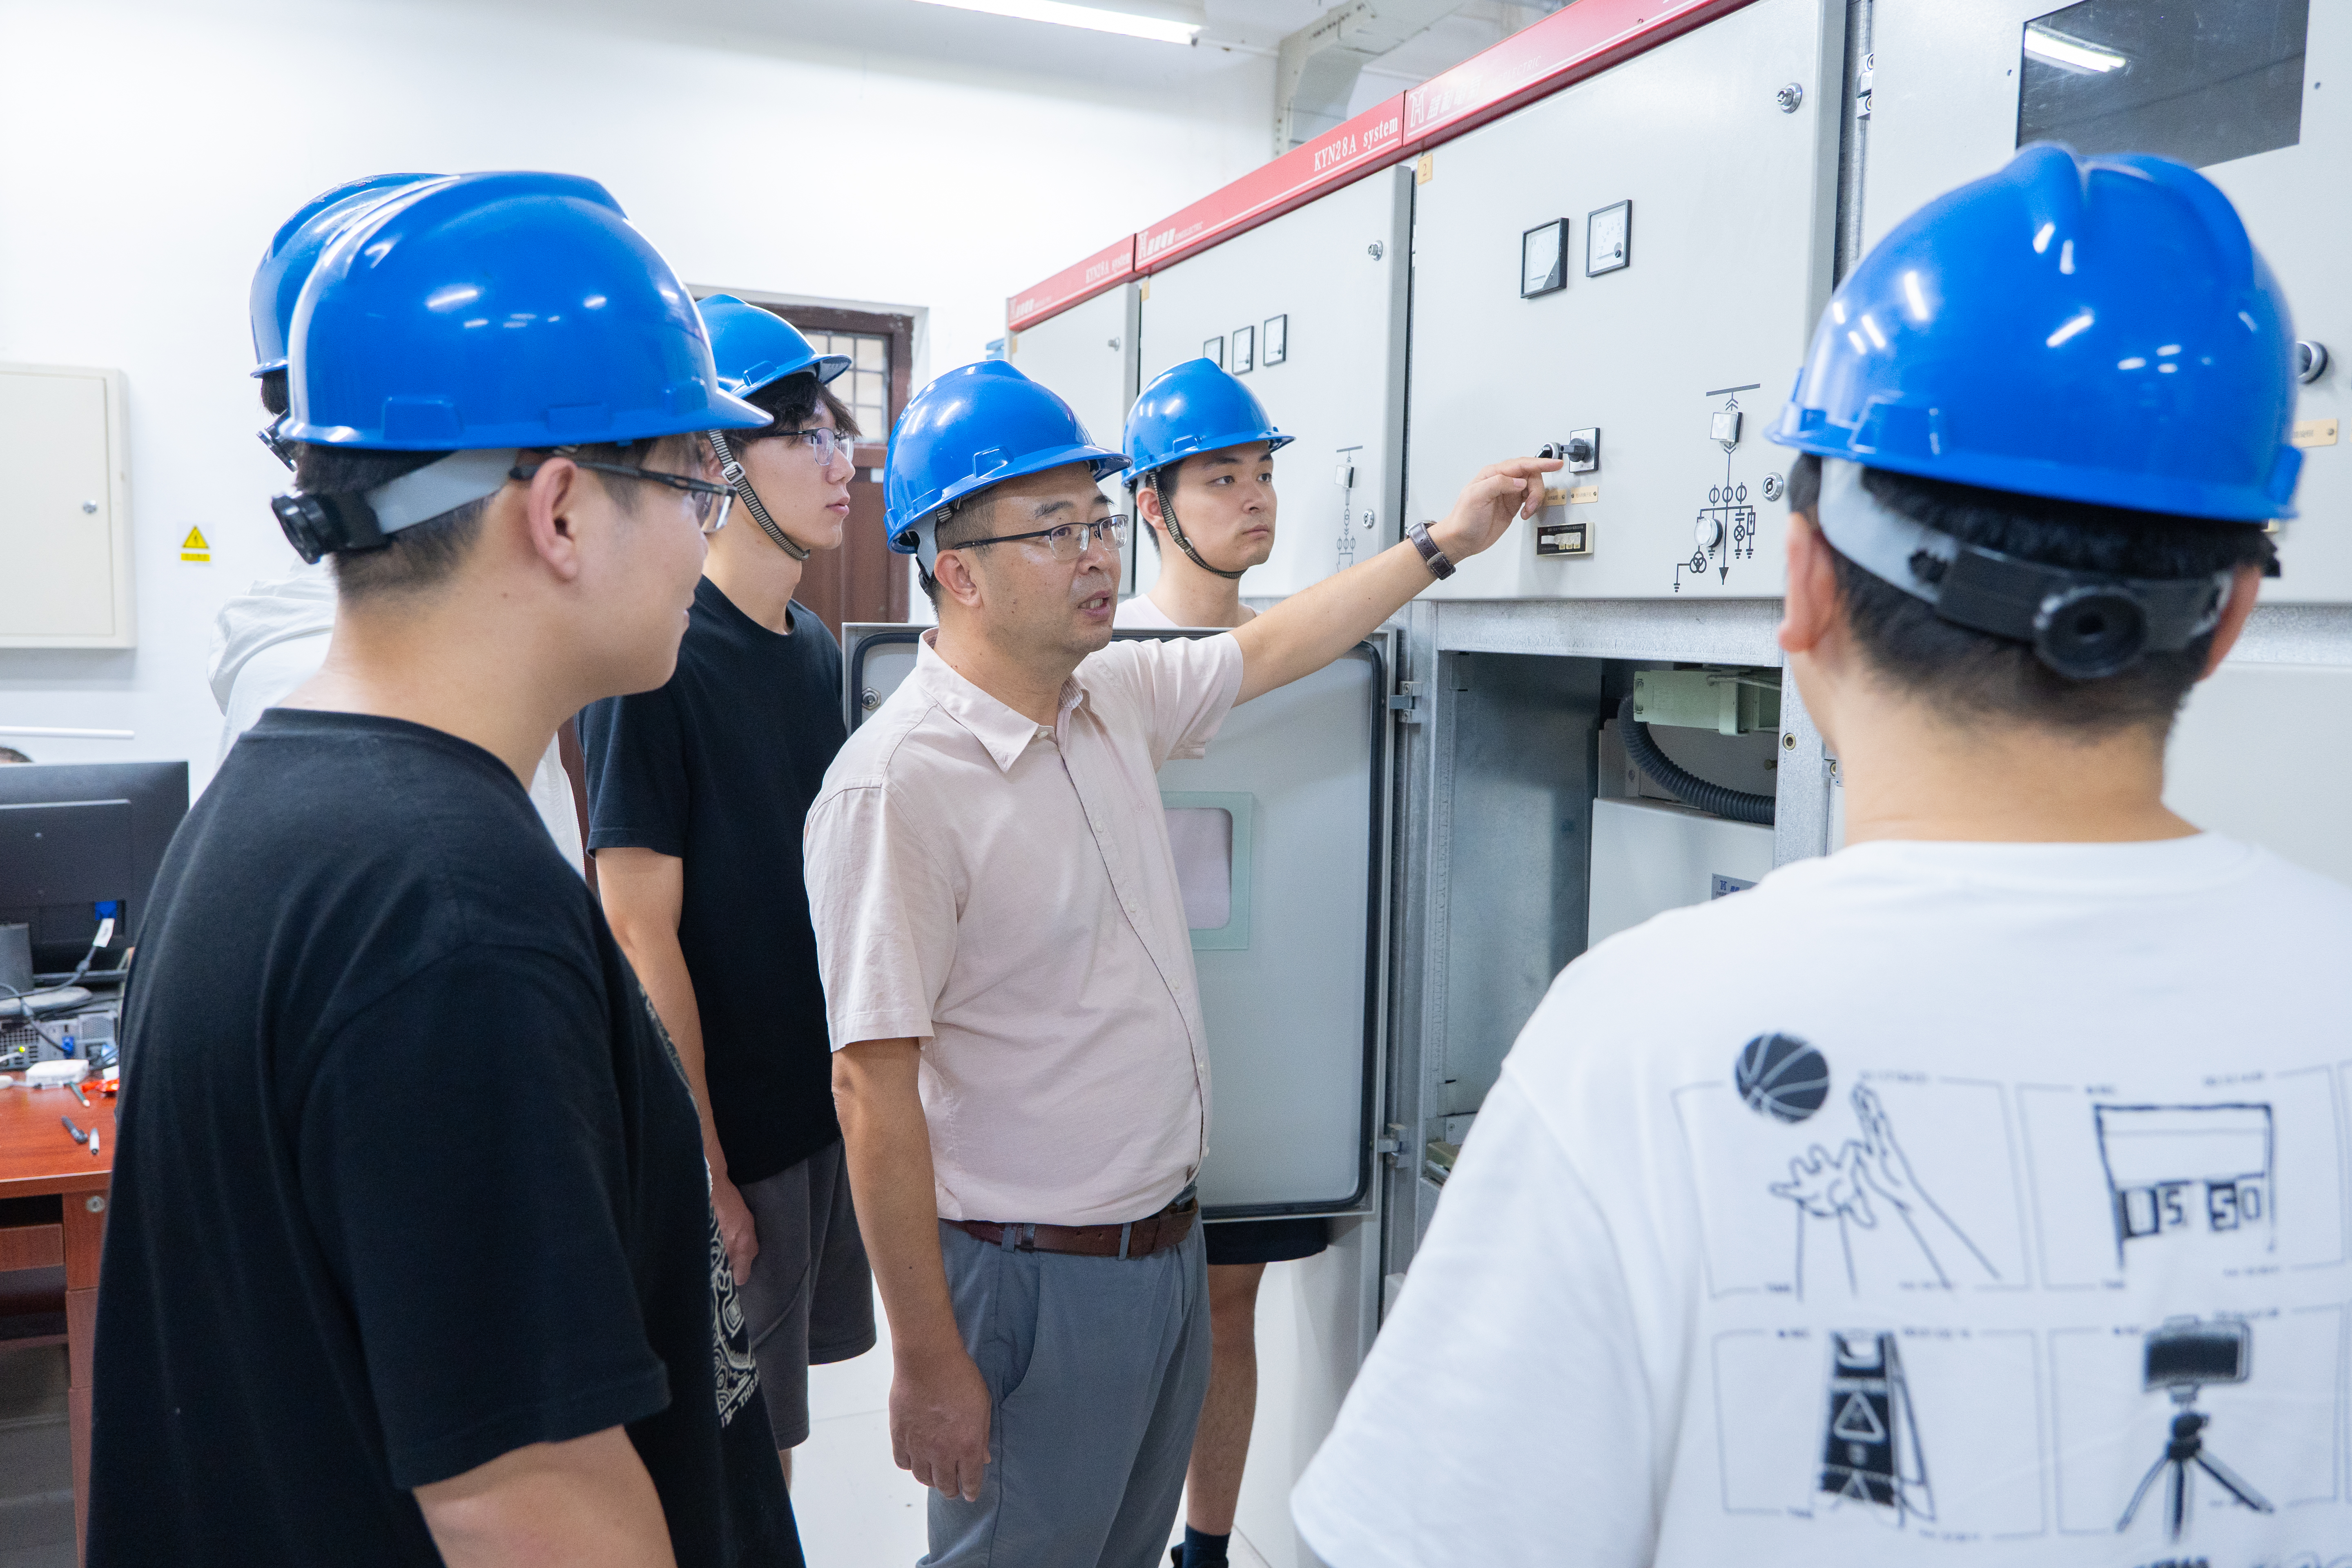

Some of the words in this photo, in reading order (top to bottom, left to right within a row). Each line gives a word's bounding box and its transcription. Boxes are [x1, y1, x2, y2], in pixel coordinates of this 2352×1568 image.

[1314, 134, 1357, 172] KYN28A
[1363, 117, 1398, 150] system
[1422, 163, 1427, 177] 2
